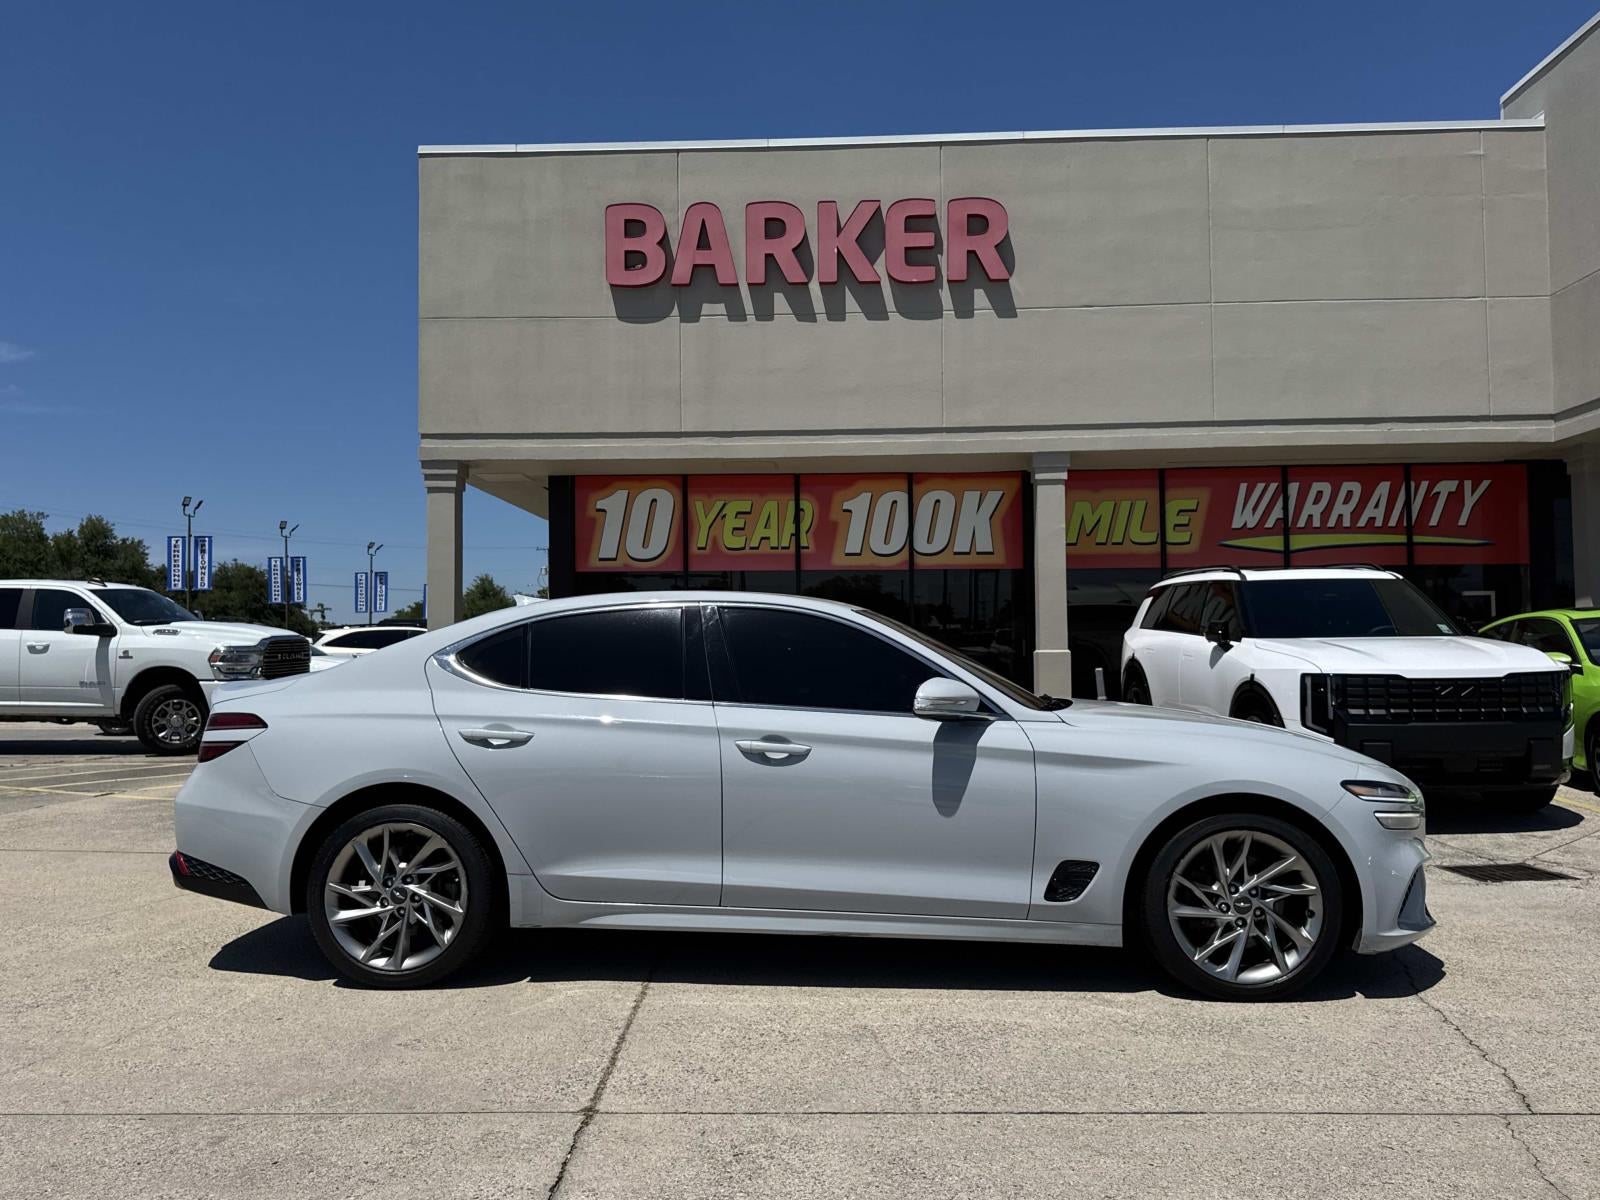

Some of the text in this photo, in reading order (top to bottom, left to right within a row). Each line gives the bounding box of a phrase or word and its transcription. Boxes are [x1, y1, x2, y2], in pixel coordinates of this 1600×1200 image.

[605, 197, 1010, 287] BARKER
[596, 479, 1493, 562] 10 YEAR 100K MILE WARRANTY
